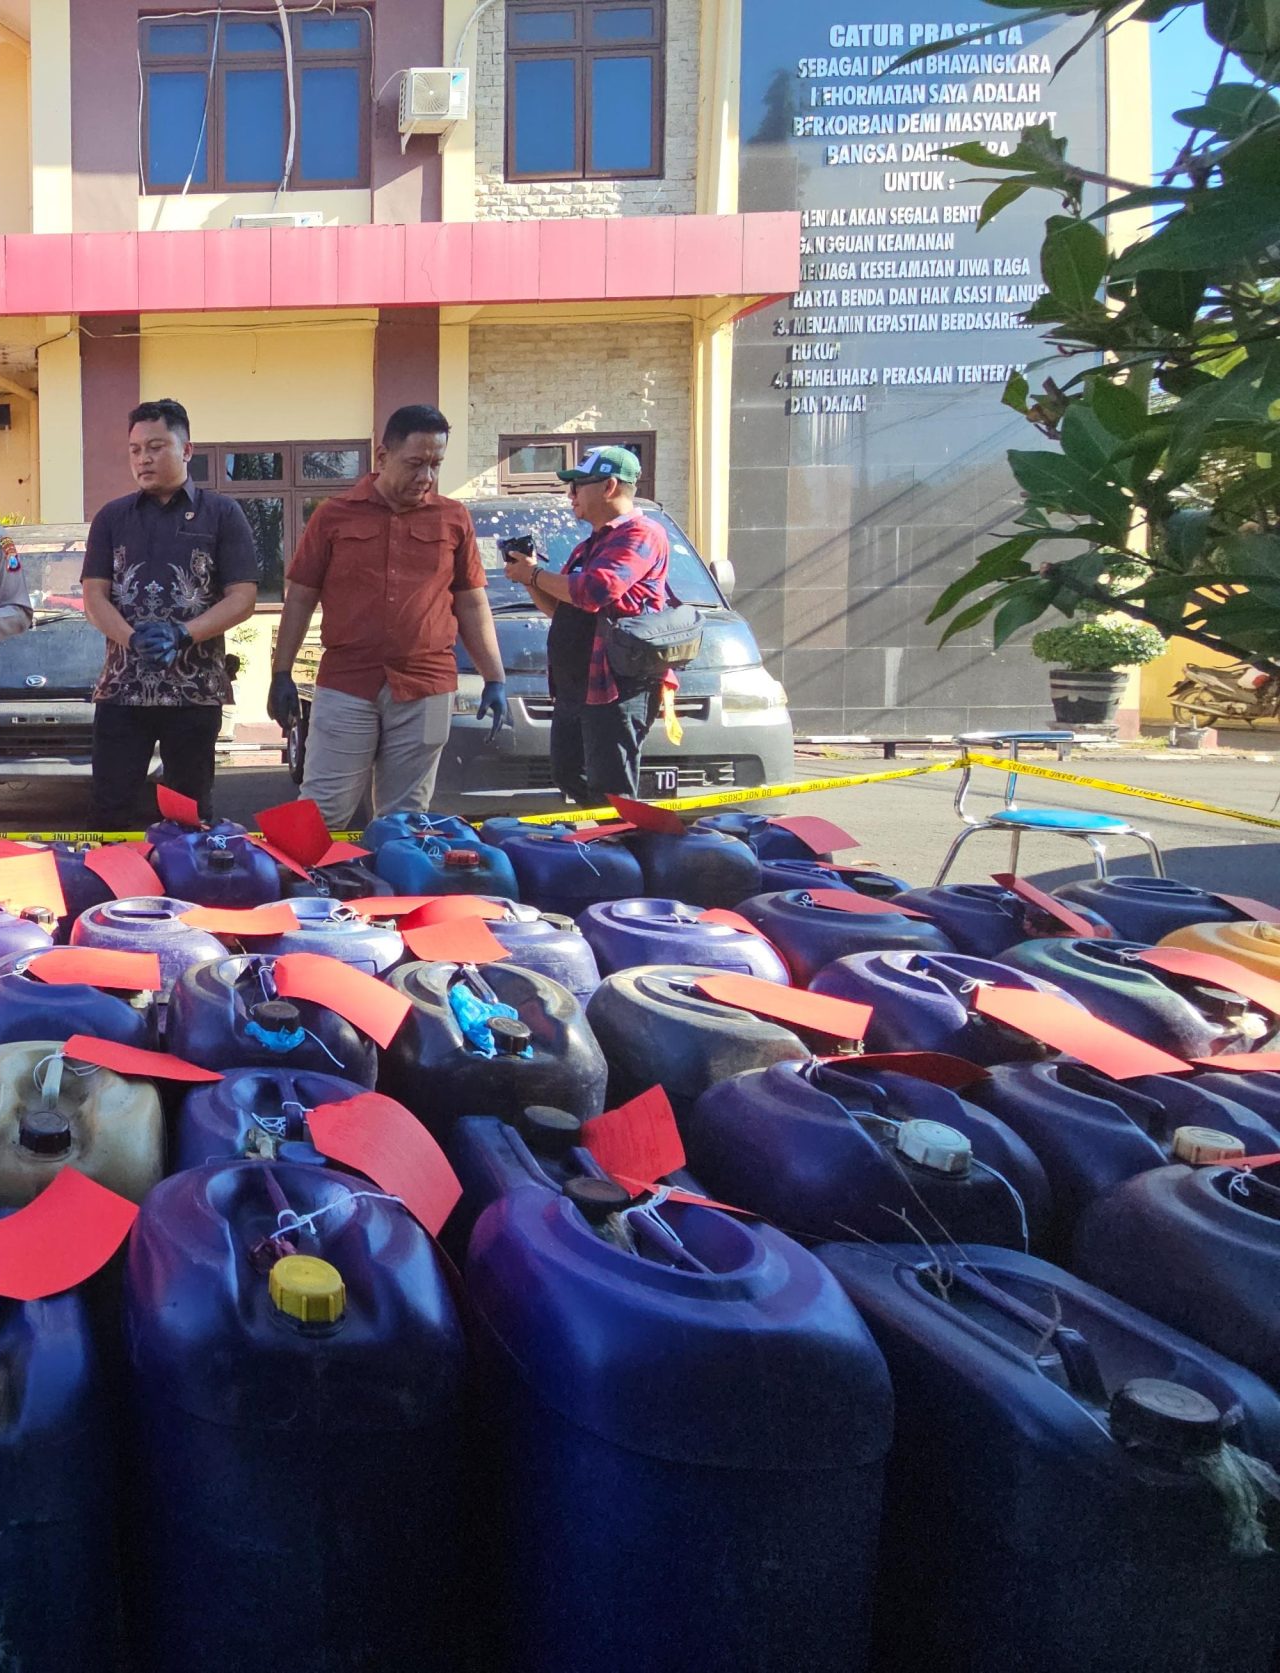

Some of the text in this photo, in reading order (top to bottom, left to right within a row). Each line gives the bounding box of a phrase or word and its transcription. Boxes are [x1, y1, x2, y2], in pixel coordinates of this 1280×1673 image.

[829, 24, 904, 48] CATUR
[798, 56, 868, 78] SEBAGAI
[927, 54, 1051, 75] BHAYANGKARA
[929, 83, 968, 104] SAYA
[973, 83, 1040, 103] ADALAH
[793, 114, 894, 137] BERKORBAN
[898, 113, 940, 135] DEMI
[827, 143, 898, 165] BANGSA
[902, 142, 938, 163] DAN
[884, 171, 944, 192] UNTUK
[889, 206, 939, 225] SEGALA
[799, 232, 955, 255] GANGGUAN KEAMANAN
[860, 259, 954, 279] KESELAMATAN
[957, 258, 990, 276] JIWA
[993, 257, 1031, 276] RAGA
[793, 290, 838, 308] HARTA
[841, 288, 885, 307] BENDA
[889, 287, 918, 305] DAN
[920, 286, 950, 304] HAK
[953, 286, 992, 303] ASASI
[794, 316, 864, 334] MENJAMIN
[867, 313, 939, 332] KEPASTIAN
[792, 368, 878, 387] MEMELIHARA
[882, 366, 953, 385] PERASAAN
[791, 394, 867, 414] DAN DAMAI
[655, 771, 676, 790] TD
